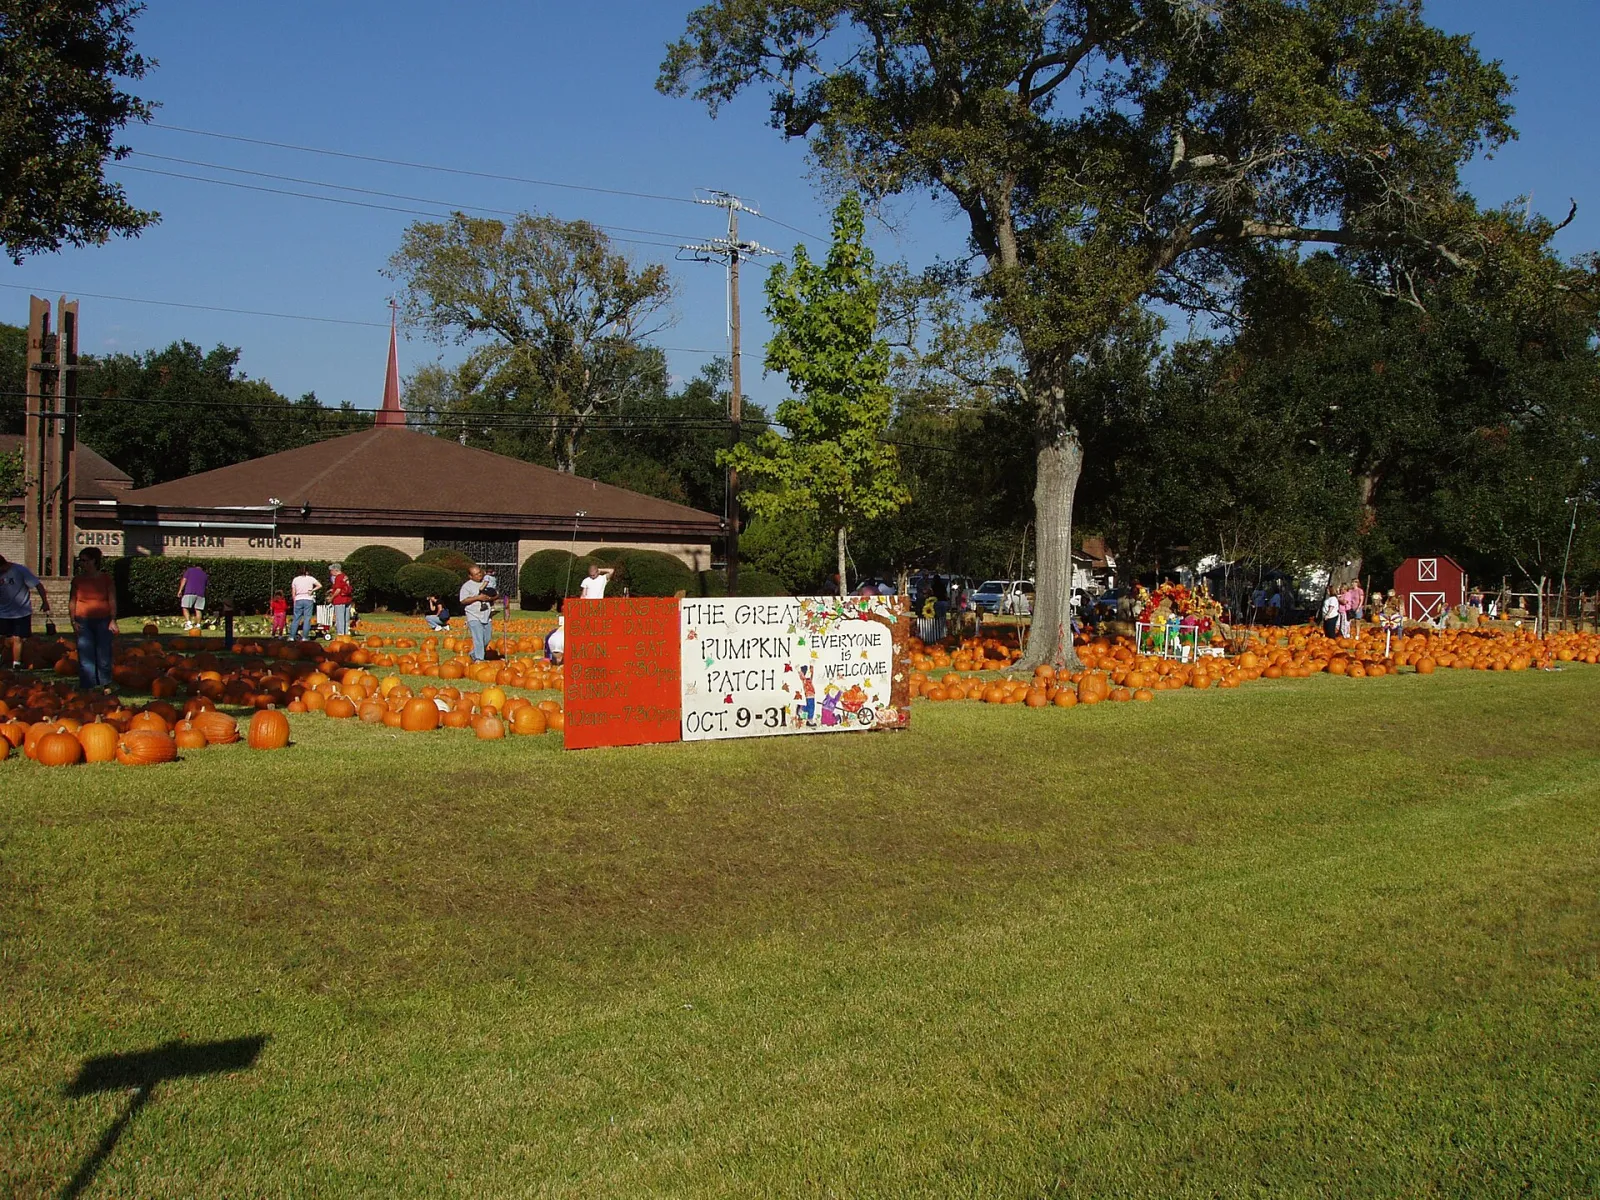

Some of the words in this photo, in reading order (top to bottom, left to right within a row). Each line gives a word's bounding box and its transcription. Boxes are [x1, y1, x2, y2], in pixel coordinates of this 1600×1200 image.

[153, 533, 225, 548] LUTHERAN
[248, 536, 301, 549] CHURCH
[567, 600, 650, 618] PUMPKINS
[683, 603, 725, 625] THE
[734, 604, 800, 625] GREAT
[570, 619, 613, 636] SALE
[623, 618, 668, 635] DAILY
[701, 637, 791, 660] PUMPKIN
[811, 633, 882, 649] EVERYONE
[824, 661, 888, 678] WELCOME
[707, 669, 775, 693] PATCH
[567, 681, 632, 701] SUNDAY
[686, 710, 728, 733] OCT.
